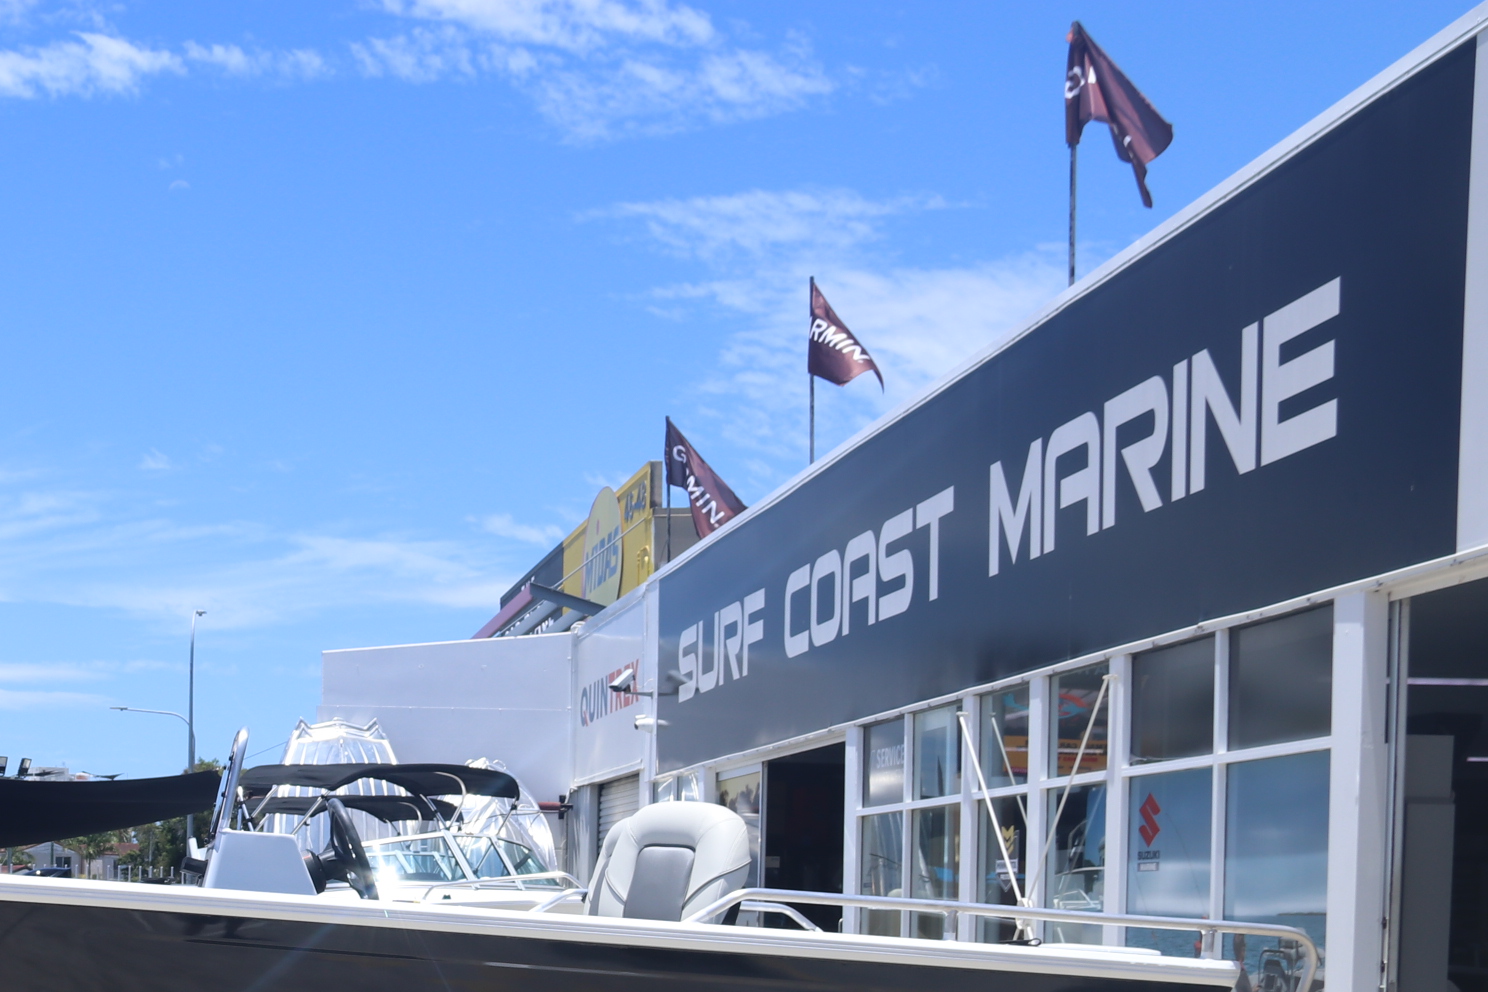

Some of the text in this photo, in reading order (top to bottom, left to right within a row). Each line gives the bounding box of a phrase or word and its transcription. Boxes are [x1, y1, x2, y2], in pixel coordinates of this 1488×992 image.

[810, 317, 871, 363] RMIN
[672, 445, 726, 526] GMIN
[678, 276, 1342, 704] SURF COAST MARINE
[585, 525, 620, 593] MIDAS
